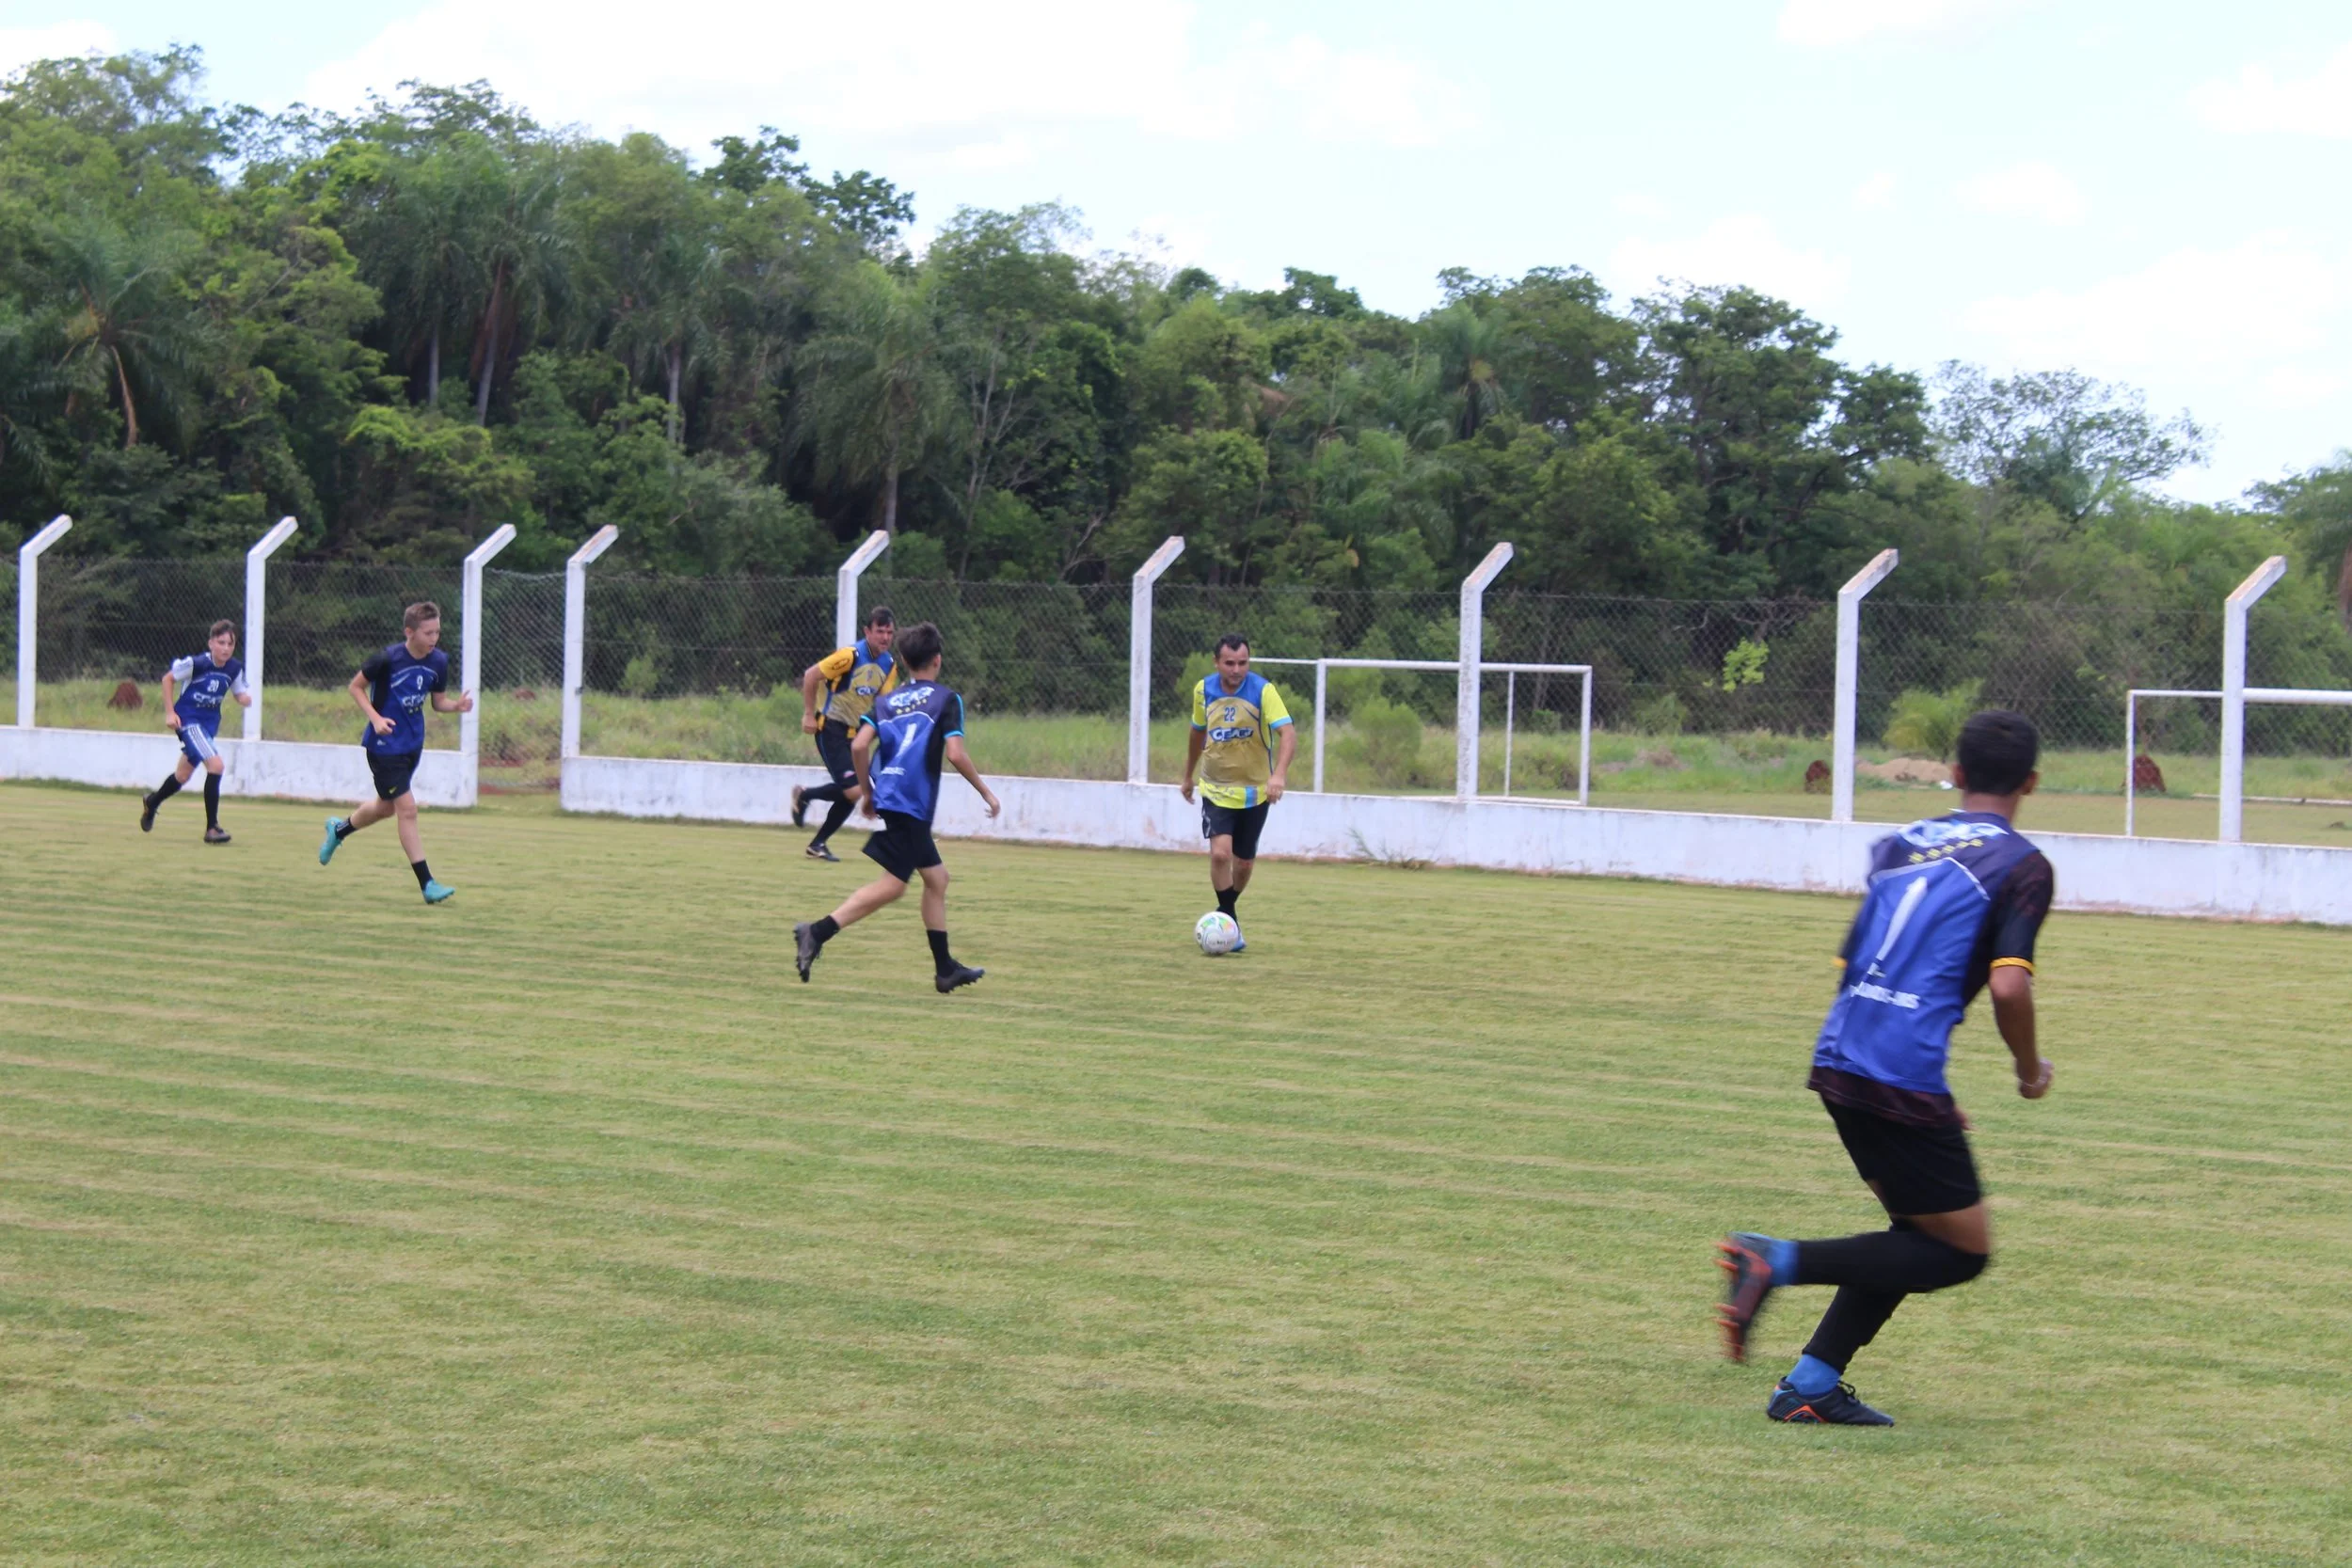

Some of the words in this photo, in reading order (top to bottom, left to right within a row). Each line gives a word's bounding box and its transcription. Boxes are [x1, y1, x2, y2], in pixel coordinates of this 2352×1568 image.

[416, 674, 423, 690] 9
[1224, 706, 1236, 722] 22
[1876, 876, 1928, 960] 1
